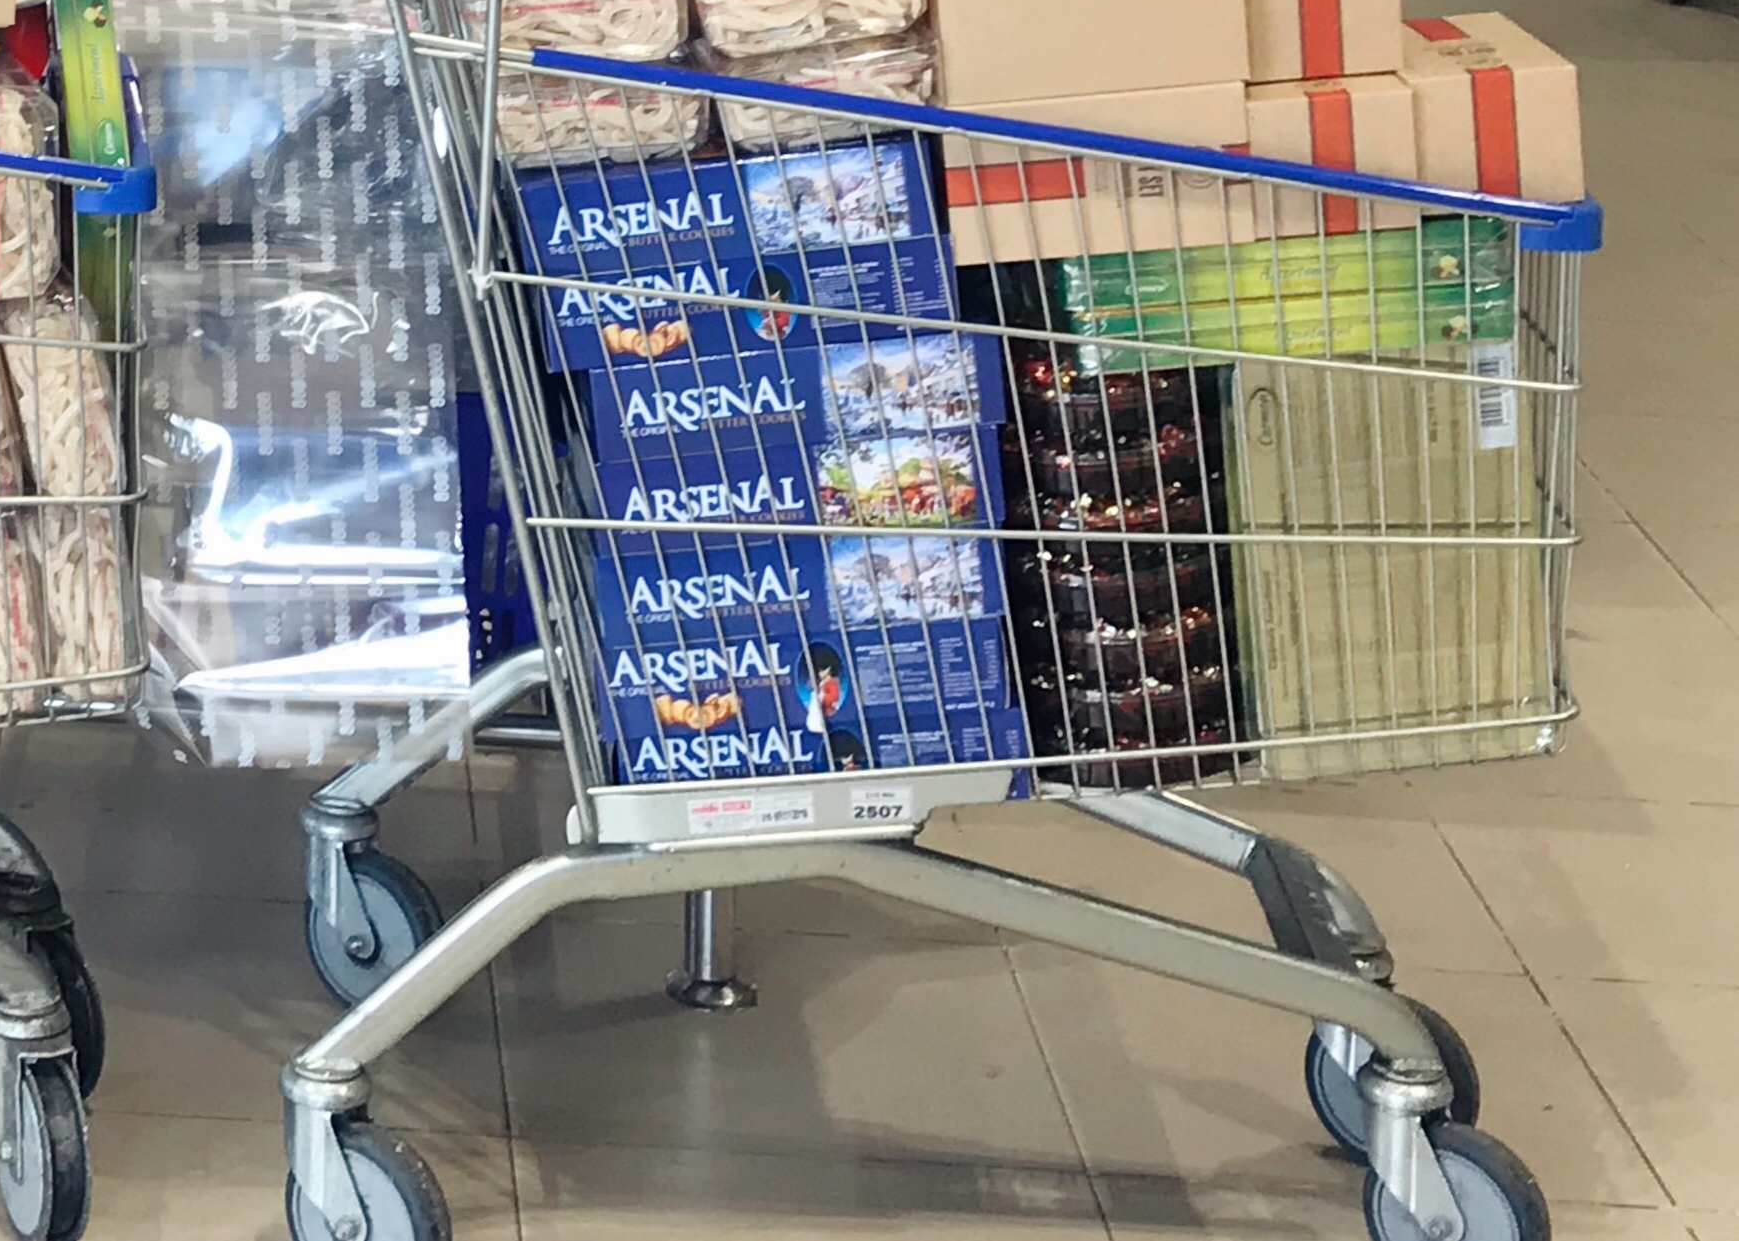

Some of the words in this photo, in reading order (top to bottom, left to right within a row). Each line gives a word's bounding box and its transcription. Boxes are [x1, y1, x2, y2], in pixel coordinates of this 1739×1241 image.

[547, 190, 735, 248] ARSENAL
[628, 232, 679, 247] BUTTR
[556, 265, 741, 321] ARSENAL
[619, 375, 807, 431] ARSENAL
[622, 473, 805, 523] ARSENAL
[625, 564, 811, 620] ARSENAL
[609, 639, 792, 692] ARSENAL
[632, 726, 815, 778] ARSENAL
[853, 804, 905, 820] 2507
